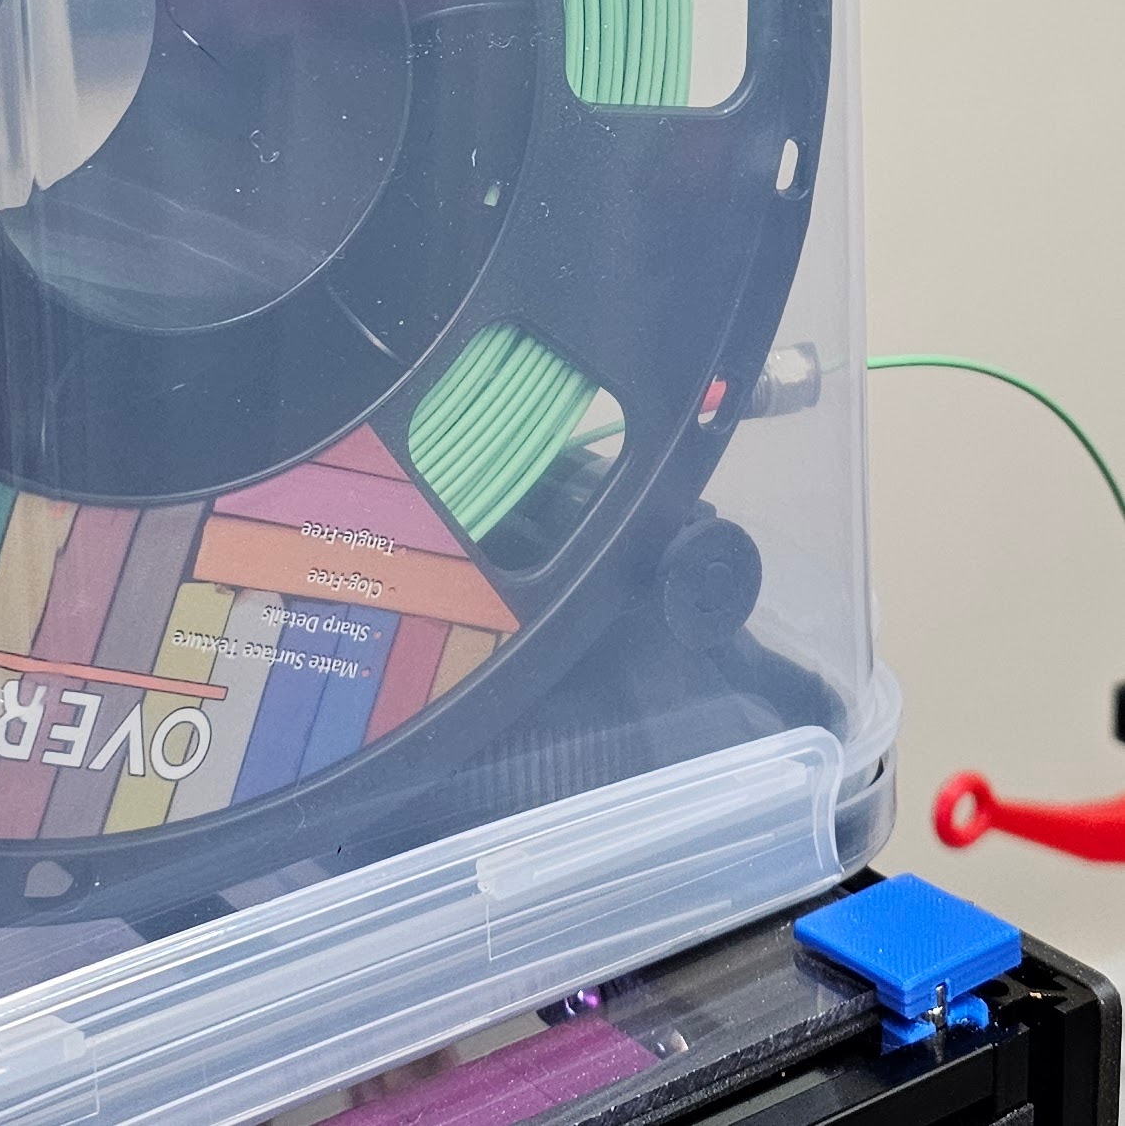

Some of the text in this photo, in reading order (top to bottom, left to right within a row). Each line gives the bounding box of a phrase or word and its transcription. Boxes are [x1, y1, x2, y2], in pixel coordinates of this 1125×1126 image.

[301, 522, 395, 556] Tangle-Free
[306, 569, 383, 599] Clog-Free
[261, 605, 371, 642] Sharp Details
[172, 630, 359, 678] Matte Surface Texture
